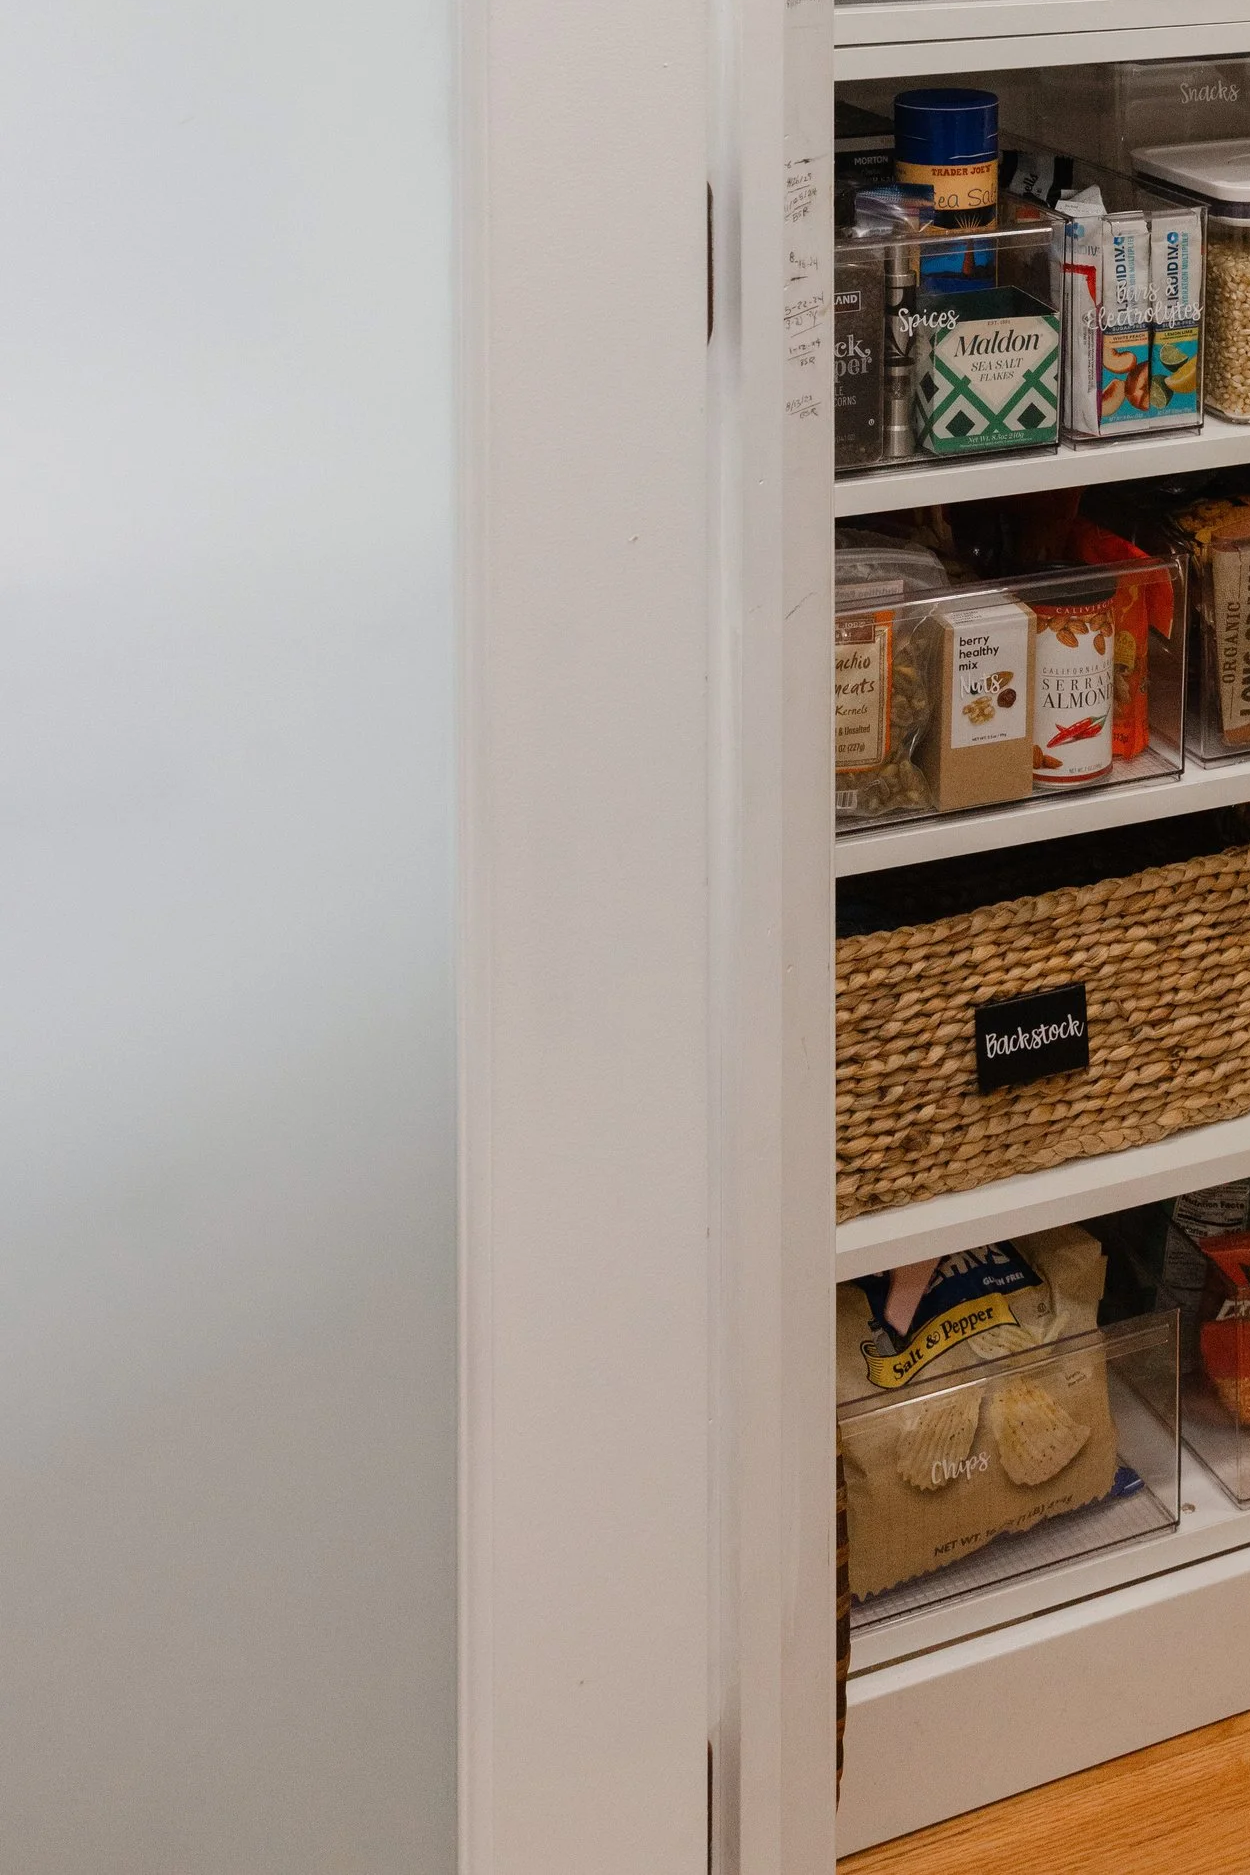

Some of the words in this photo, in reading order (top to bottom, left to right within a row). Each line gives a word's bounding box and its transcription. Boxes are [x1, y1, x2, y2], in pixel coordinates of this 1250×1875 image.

[1179, 80, 1240, 104] Snacks
[854, 155, 889, 165] MORTON
[931, 167, 967, 177] TRADER
[1116, 281, 1159, 304] Bars
[898, 307, 960, 338] Spices
[1088, 300, 1204, 331] Electrolytes
[954, 329, 1041, 359] Maldon
[971, 359, 992, 373] SEA
[994, 357, 1023, 371] SALT
[980, 371, 1015, 383] FLAKES
[959, 635, 990, 647] berry
[1222, 601, 1241, 684] ORGANIC
[959, 645, 999, 660] healthy
[958, 661, 978, 671] mix
[1043, 664, 1099, 675] CALIFORNIA
[960, 671, 1002, 699] Nuts
[835, 706, 868, 716] Kernels
[844, 724, 870, 736] Unsalted
[985, 1013, 1084, 1059] Backstock
[940, 1304, 995, 1338] Pepper
[892, 1349, 923, 1381] Salt
[925, 1331, 941, 1350] &
[931, 1450, 991, 1485] Chips
[934, 1540, 957, 1556] NET
